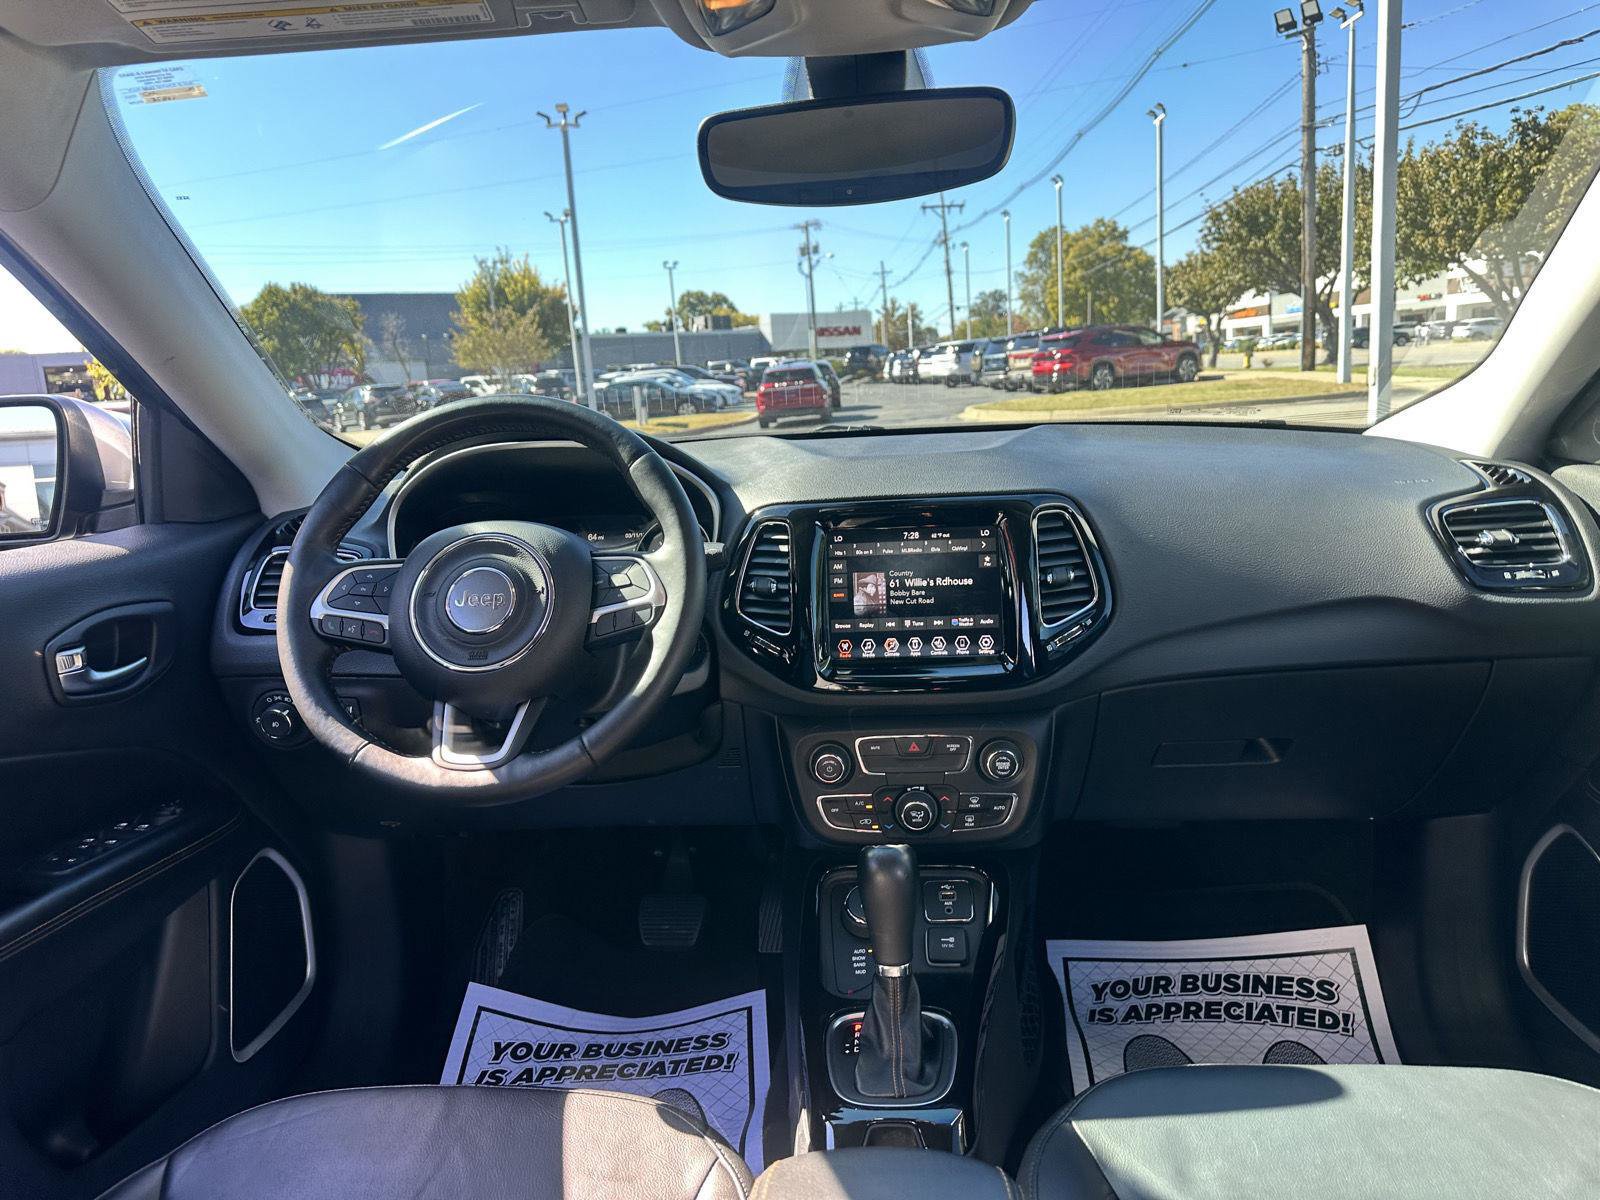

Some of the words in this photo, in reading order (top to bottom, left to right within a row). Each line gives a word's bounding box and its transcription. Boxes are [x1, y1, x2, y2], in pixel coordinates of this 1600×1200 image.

[587, 533, 597, 541] 64
[834, 535, 843, 543] LO
[903, 532, 920, 540] 7:28
[980, 529, 990, 537] LO
[889, 579, 900, 588] 61
[904, 578, 935, 587] Willie's
[936, 577, 974, 586] Rdhouse
[454, 590, 505, 612] Jeep
[1090, 974, 1176, 1002] YOUR
[1179, 972, 1341, 1003] BUSINESS
[1087, 1007, 1116, 1024] IS
[1117, 1001, 1355, 1036] APPRECIATED!
[490, 1040, 579, 1063] YOUR
[579, 1031, 733, 1060] BUSINESS
[474, 1069, 508, 1086] IS
[512, 1052, 740, 1085] APPRECIATED!
